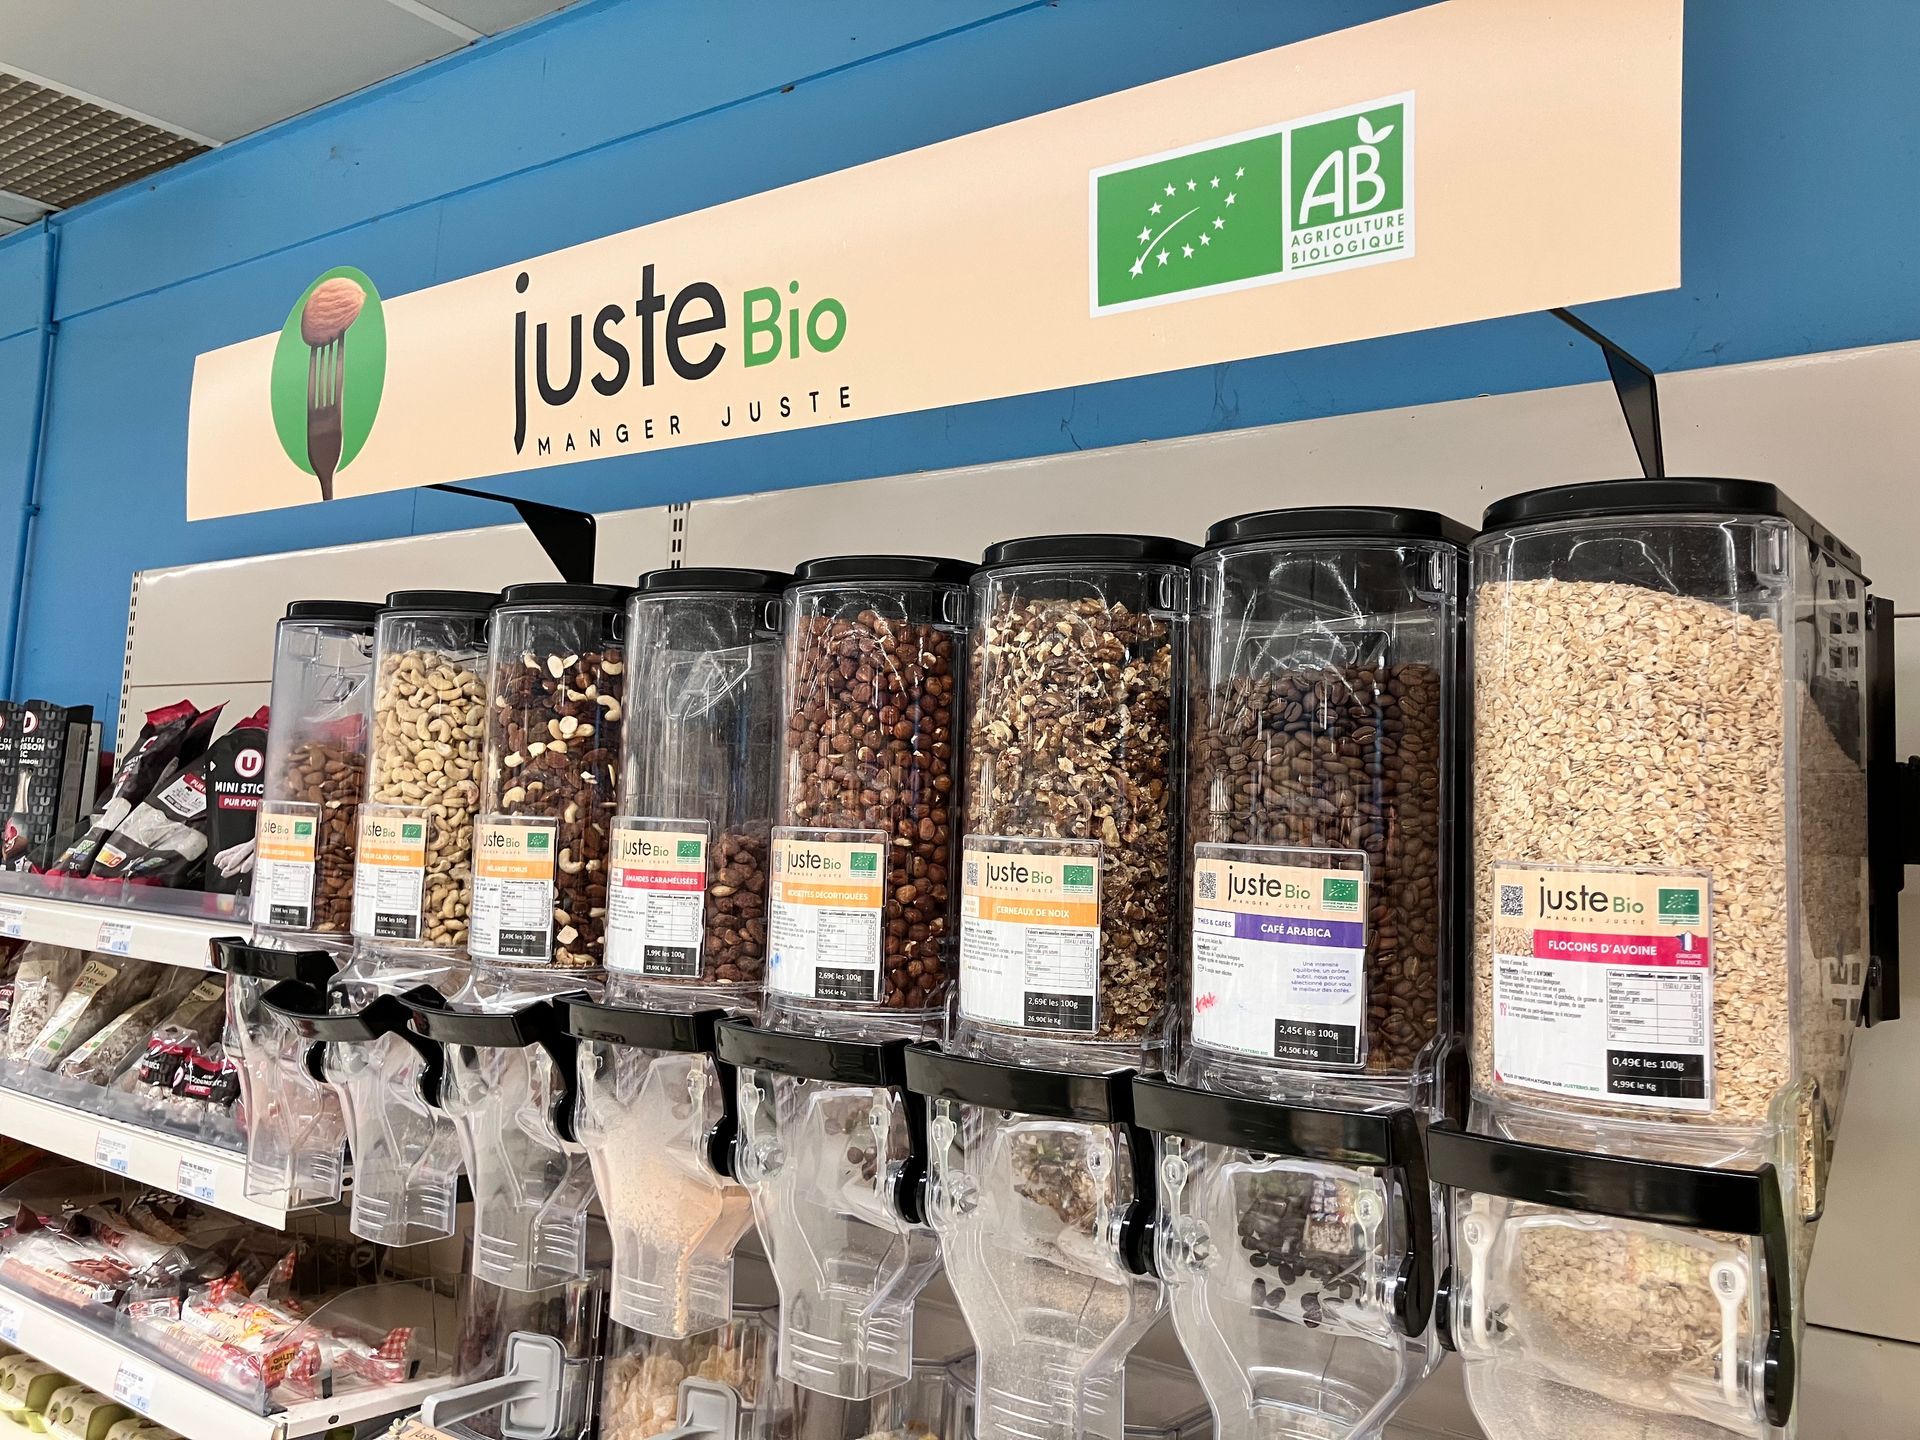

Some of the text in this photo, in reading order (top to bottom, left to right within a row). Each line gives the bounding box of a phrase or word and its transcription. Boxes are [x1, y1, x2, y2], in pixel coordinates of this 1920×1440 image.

[1298, 144, 1386, 225] AB
[1291, 213, 1405, 248] AGRICULTURE
[1291, 231, 1405, 264] BIOLOGIQUE
[514, 263, 847, 455] juste Bio
[538, 386, 851, 456] MANGER JUSTE
[242, 757, 257, 771] U
[215, 781, 238, 793] MINI
[224, 796, 240, 807] PUR
[382, 827, 396, 838] Bio
[505, 837, 520, 848] Bio
[622, 833, 669, 860] juste Bio
[787, 843, 841, 873] juste Bio
[985, 856, 1053, 887] juste Bio
[650, 874, 698, 885] CARAMÉLISÉES
[1228, 865, 1311, 901] juste Bio
[815, 890, 868, 901] DÉCORTIQUÉES
[1539, 877, 1644, 918] juste Bio
[996, 905, 1070, 918] CERNEAUX DE NOIX
[1278, 902, 1312, 910] JUSTE
[1546, 915, 1594, 923] MANGER
[1260, 920, 1332, 938] CAFÉ ARABICA
[523, 934, 536, 942] 100g
[1548, 939, 1657, 956] FLOCONS D'AVOINE
[662, 949, 670, 957] les
[671, 950, 685, 959] 100g
[1676, 952, 1702, 960] ORIGINE
[1676, 958, 1702, 966] FRANCE
[818, 971, 862, 982] 2,69€ les 100g
[840, 989, 847, 997] Kg
[1028, 997, 1079, 1009] 2,69€ les 100g
[1027, 1015, 1046, 1023] 26,90€
[1053, 1017, 1061, 1025] Kg
[1279, 1025, 1339, 1040] 2,45€ les 100g
[1278, 1045, 1319, 1058] 24,50€ le Kg
[1612, 1057, 1684, 1071] 0,49€ les 100g
[1612, 1080, 1657, 1092] 4,99€ le Kg
